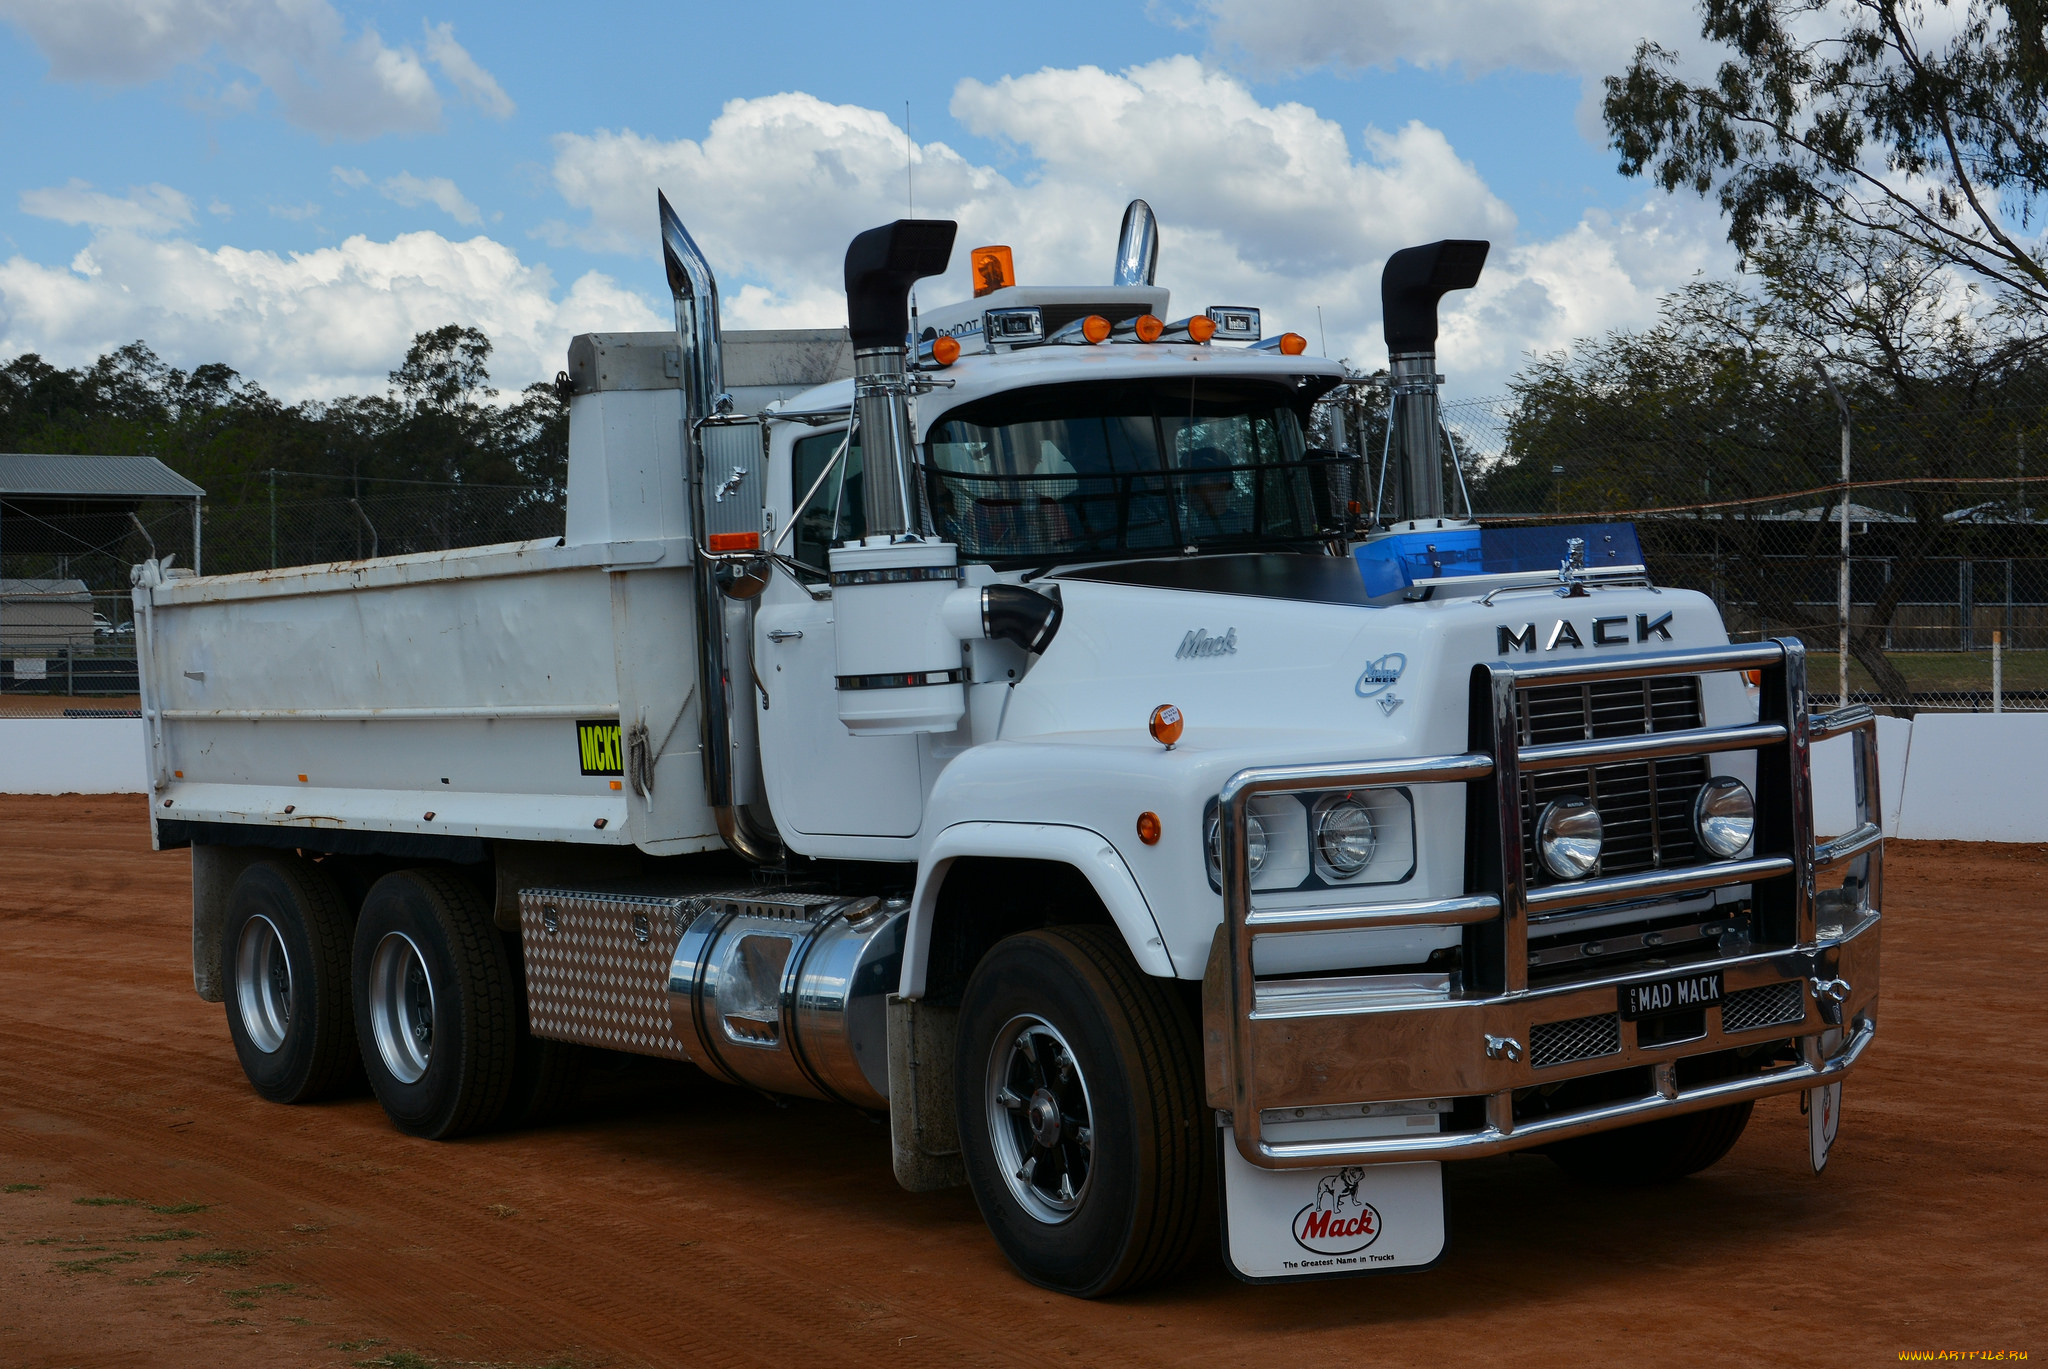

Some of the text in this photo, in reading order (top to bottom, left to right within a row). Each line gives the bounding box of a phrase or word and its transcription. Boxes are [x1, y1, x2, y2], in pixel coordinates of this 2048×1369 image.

[1175, 626, 1238, 659] Mack
[1496, 610, 1673, 656] MACK
[580, 725, 623, 771] MCK1
[1639, 975, 1719, 1012] MAD MACK
[1301, 1208, 1375, 1240] Mack
[1283, 1261, 1298, 1269] The
[1301, 1259, 1334, 1268] Greatest
[1336, 1257, 1357, 1265] Name
[1369, 1253, 1395, 1262] Trucks
